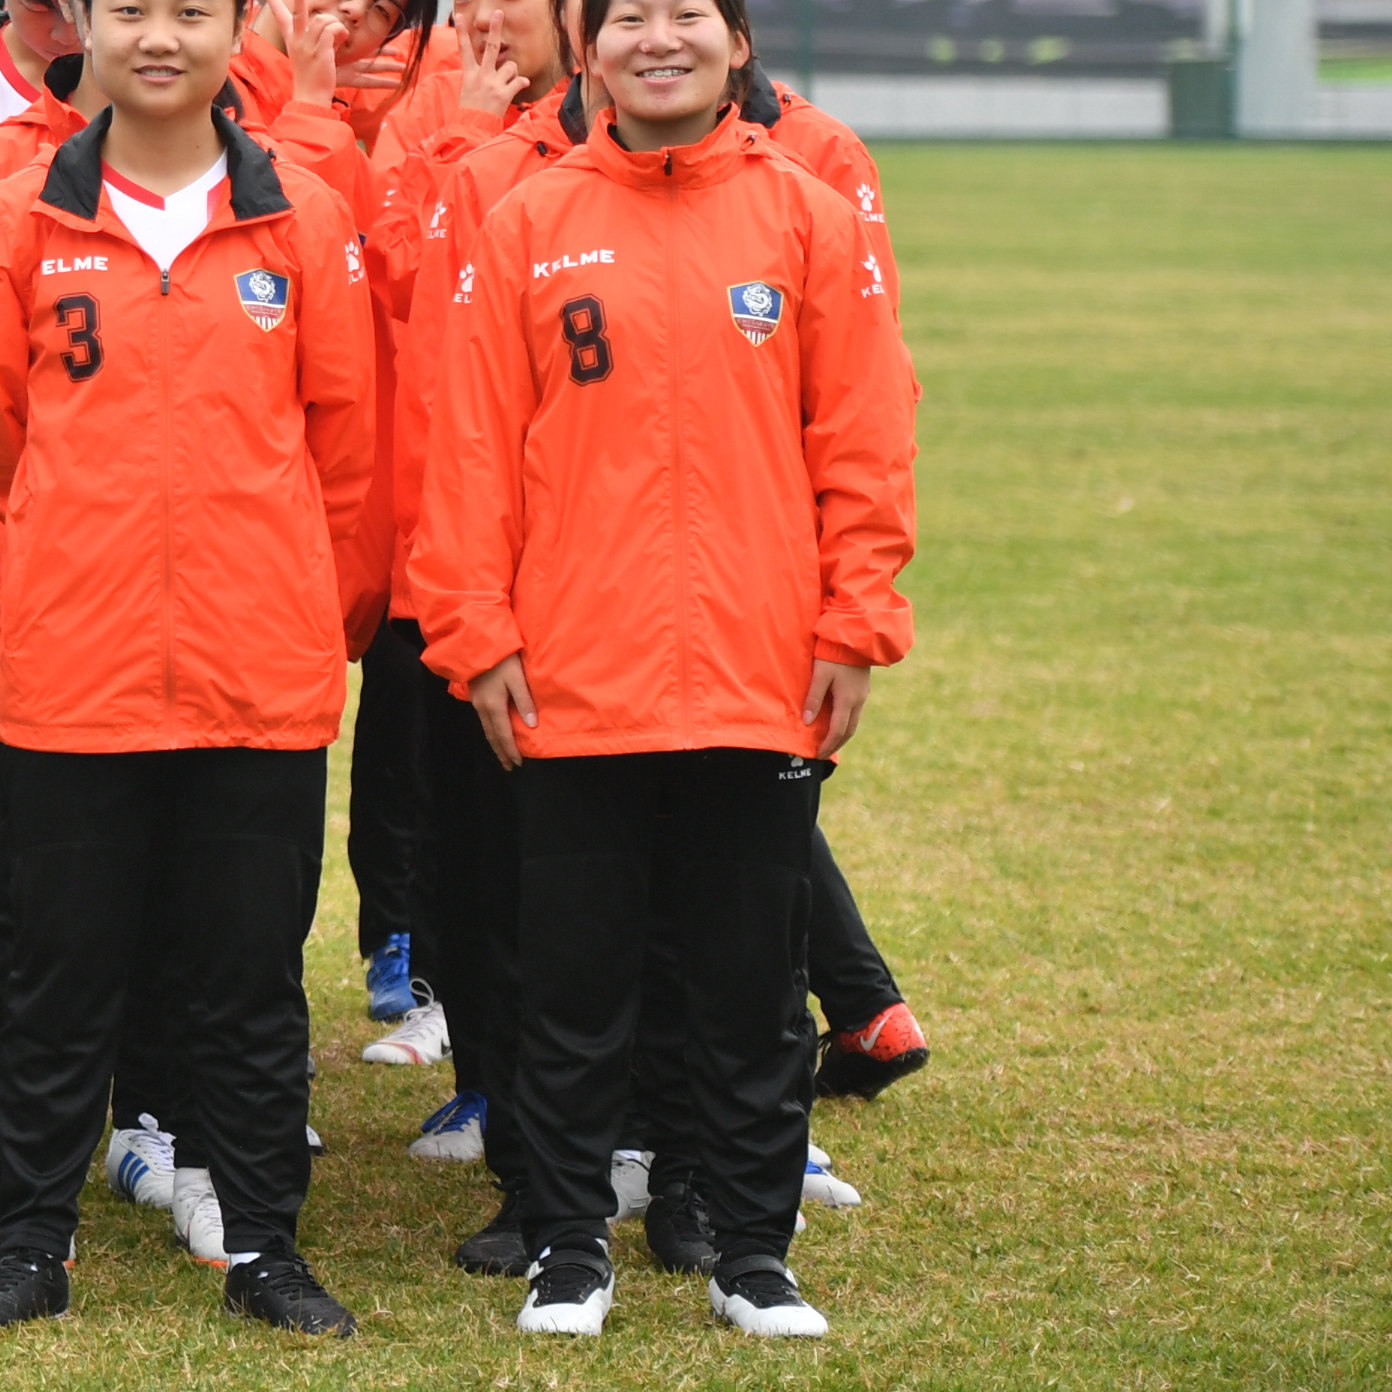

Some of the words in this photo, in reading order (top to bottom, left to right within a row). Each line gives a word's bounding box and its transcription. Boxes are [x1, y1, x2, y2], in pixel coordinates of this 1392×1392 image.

[41, 255, 109, 276] ELME
[532, 248, 616, 279] KELME
[54, 291, 105, 384] 3
[559, 293, 614, 387] 8
[778, 767, 812, 780] KELME
